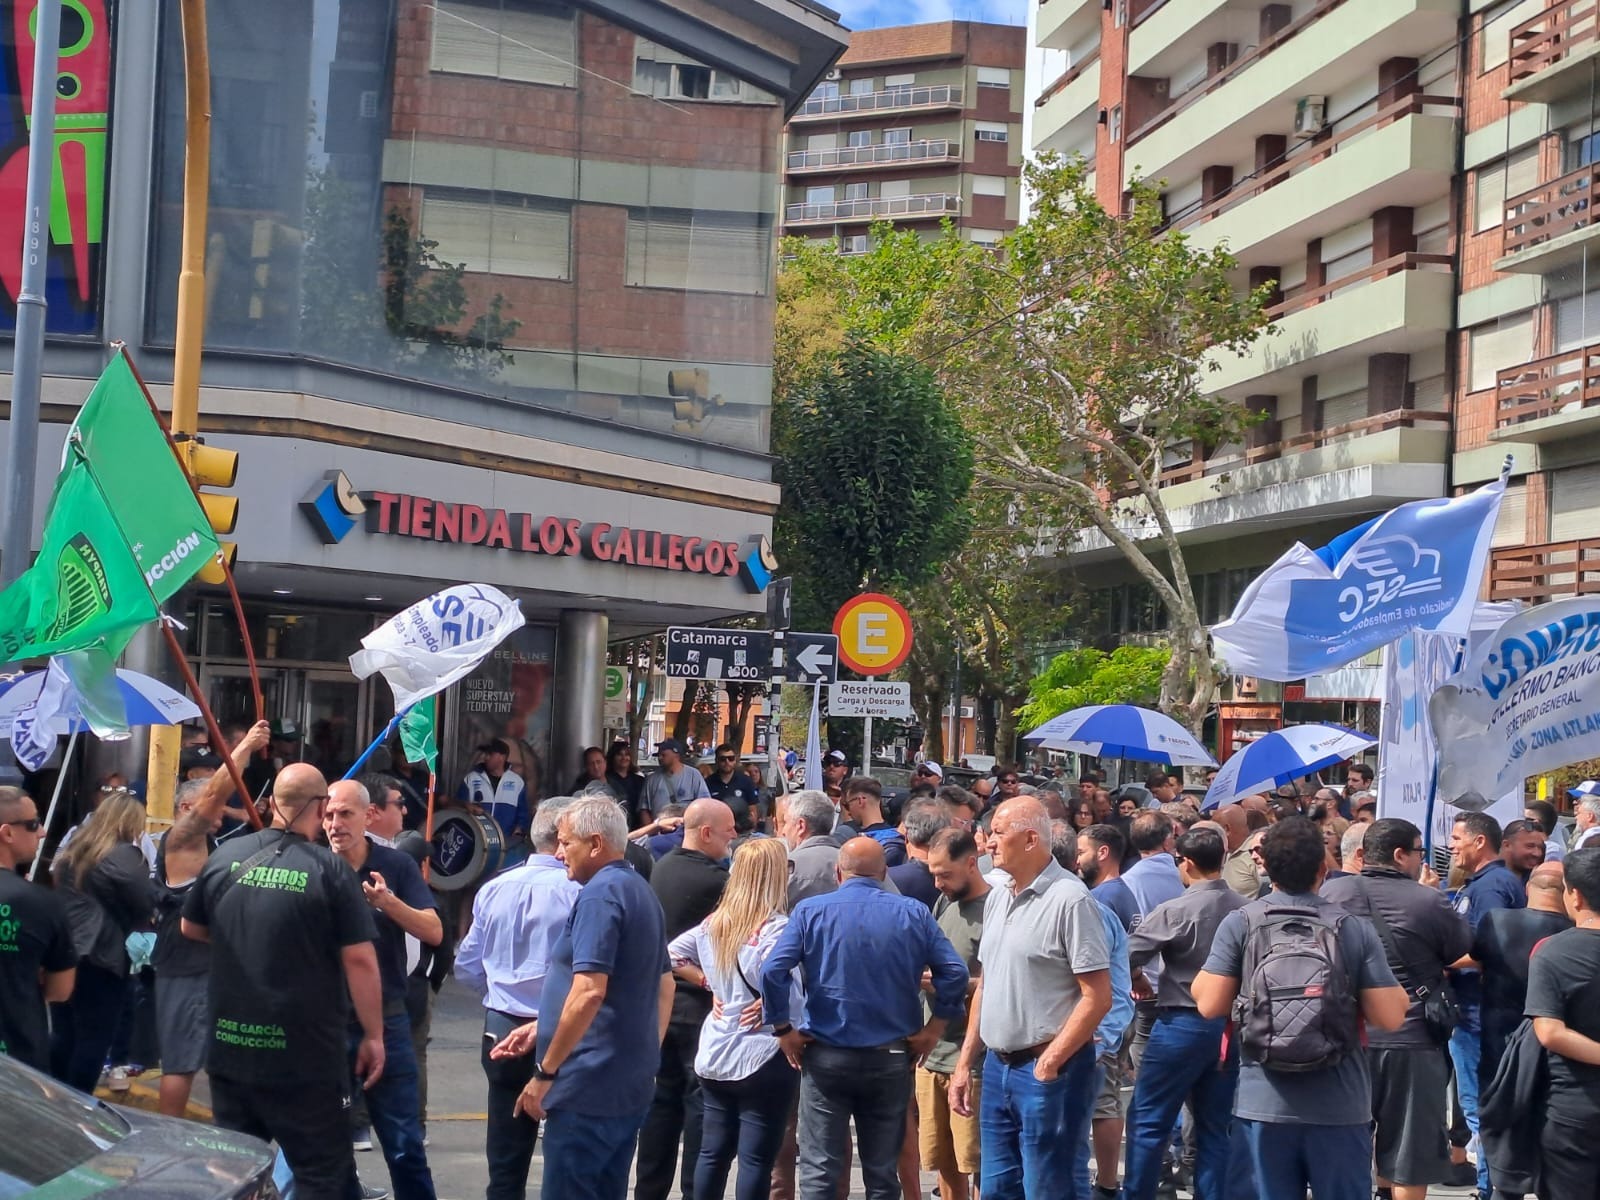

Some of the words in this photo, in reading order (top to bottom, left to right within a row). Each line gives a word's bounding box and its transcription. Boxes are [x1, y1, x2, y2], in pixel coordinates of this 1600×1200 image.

[30, 206, 40, 265] 1890
[373, 491, 513, 549] TIENDA
[521, 512, 582, 557] LOS
[591, 522, 740, 578] GALLEGOS
[671, 630, 748, 647] Catamarca
[858, 612, 889, 654] E
[669, 663, 700, 676] 1700
[466, 679, 494, 690] NUEVO
[841, 684, 902, 696] Reservado
[466, 690, 516, 702] SUPERSTAY
[837, 696, 861, 707] Carga
[868, 697, 905, 707] Descarga
[1540, 689, 1583, 716] GENERAL
[466, 701, 493, 712] TEDDY
[494, 702, 513, 713] TINT
[1531, 726, 1562, 750] ZONA
[230, 861, 309, 887] PSTELEROS
[239, 1023, 286, 1037] GARCÍA
[215, 1030, 287, 1049] CONDUCCIÓN
